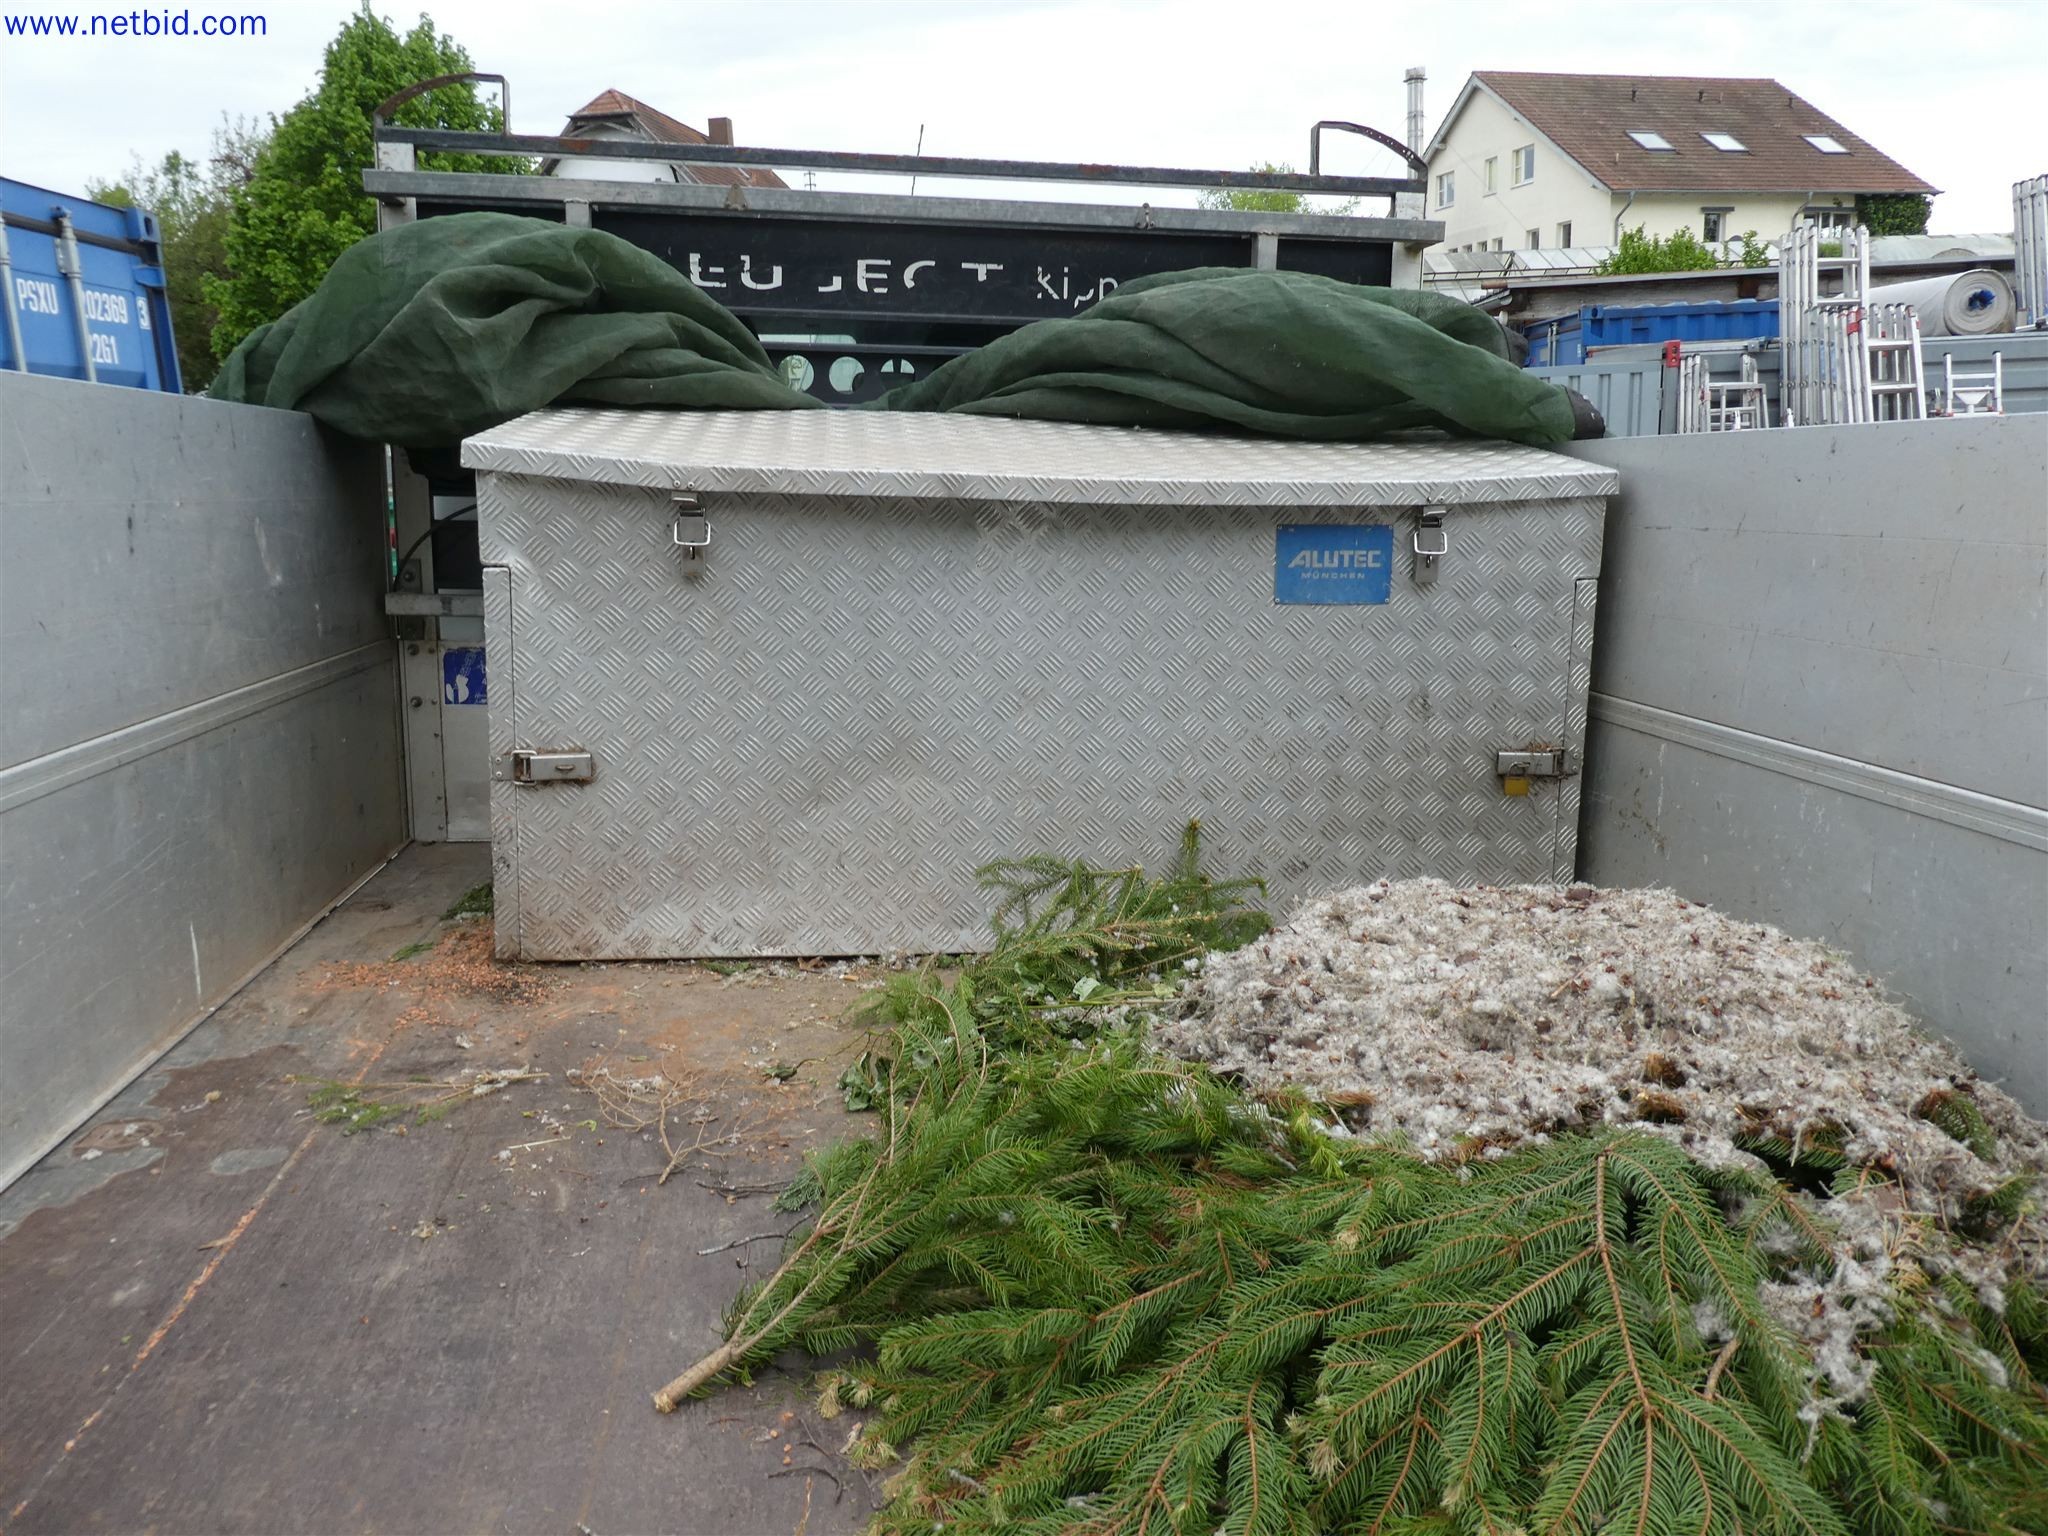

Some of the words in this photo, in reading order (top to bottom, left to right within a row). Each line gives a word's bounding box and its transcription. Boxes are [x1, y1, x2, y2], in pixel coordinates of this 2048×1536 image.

[16, 277, 59, 315] PSXU
[82, 289, 129, 324] 02369
[137, 297, 150, 329] 3
[90, 332, 119, 365] 2G1
[1288, 550, 1384, 568] ALUTEC
[1301, 570, 1366, 580] MÜNCHEN
